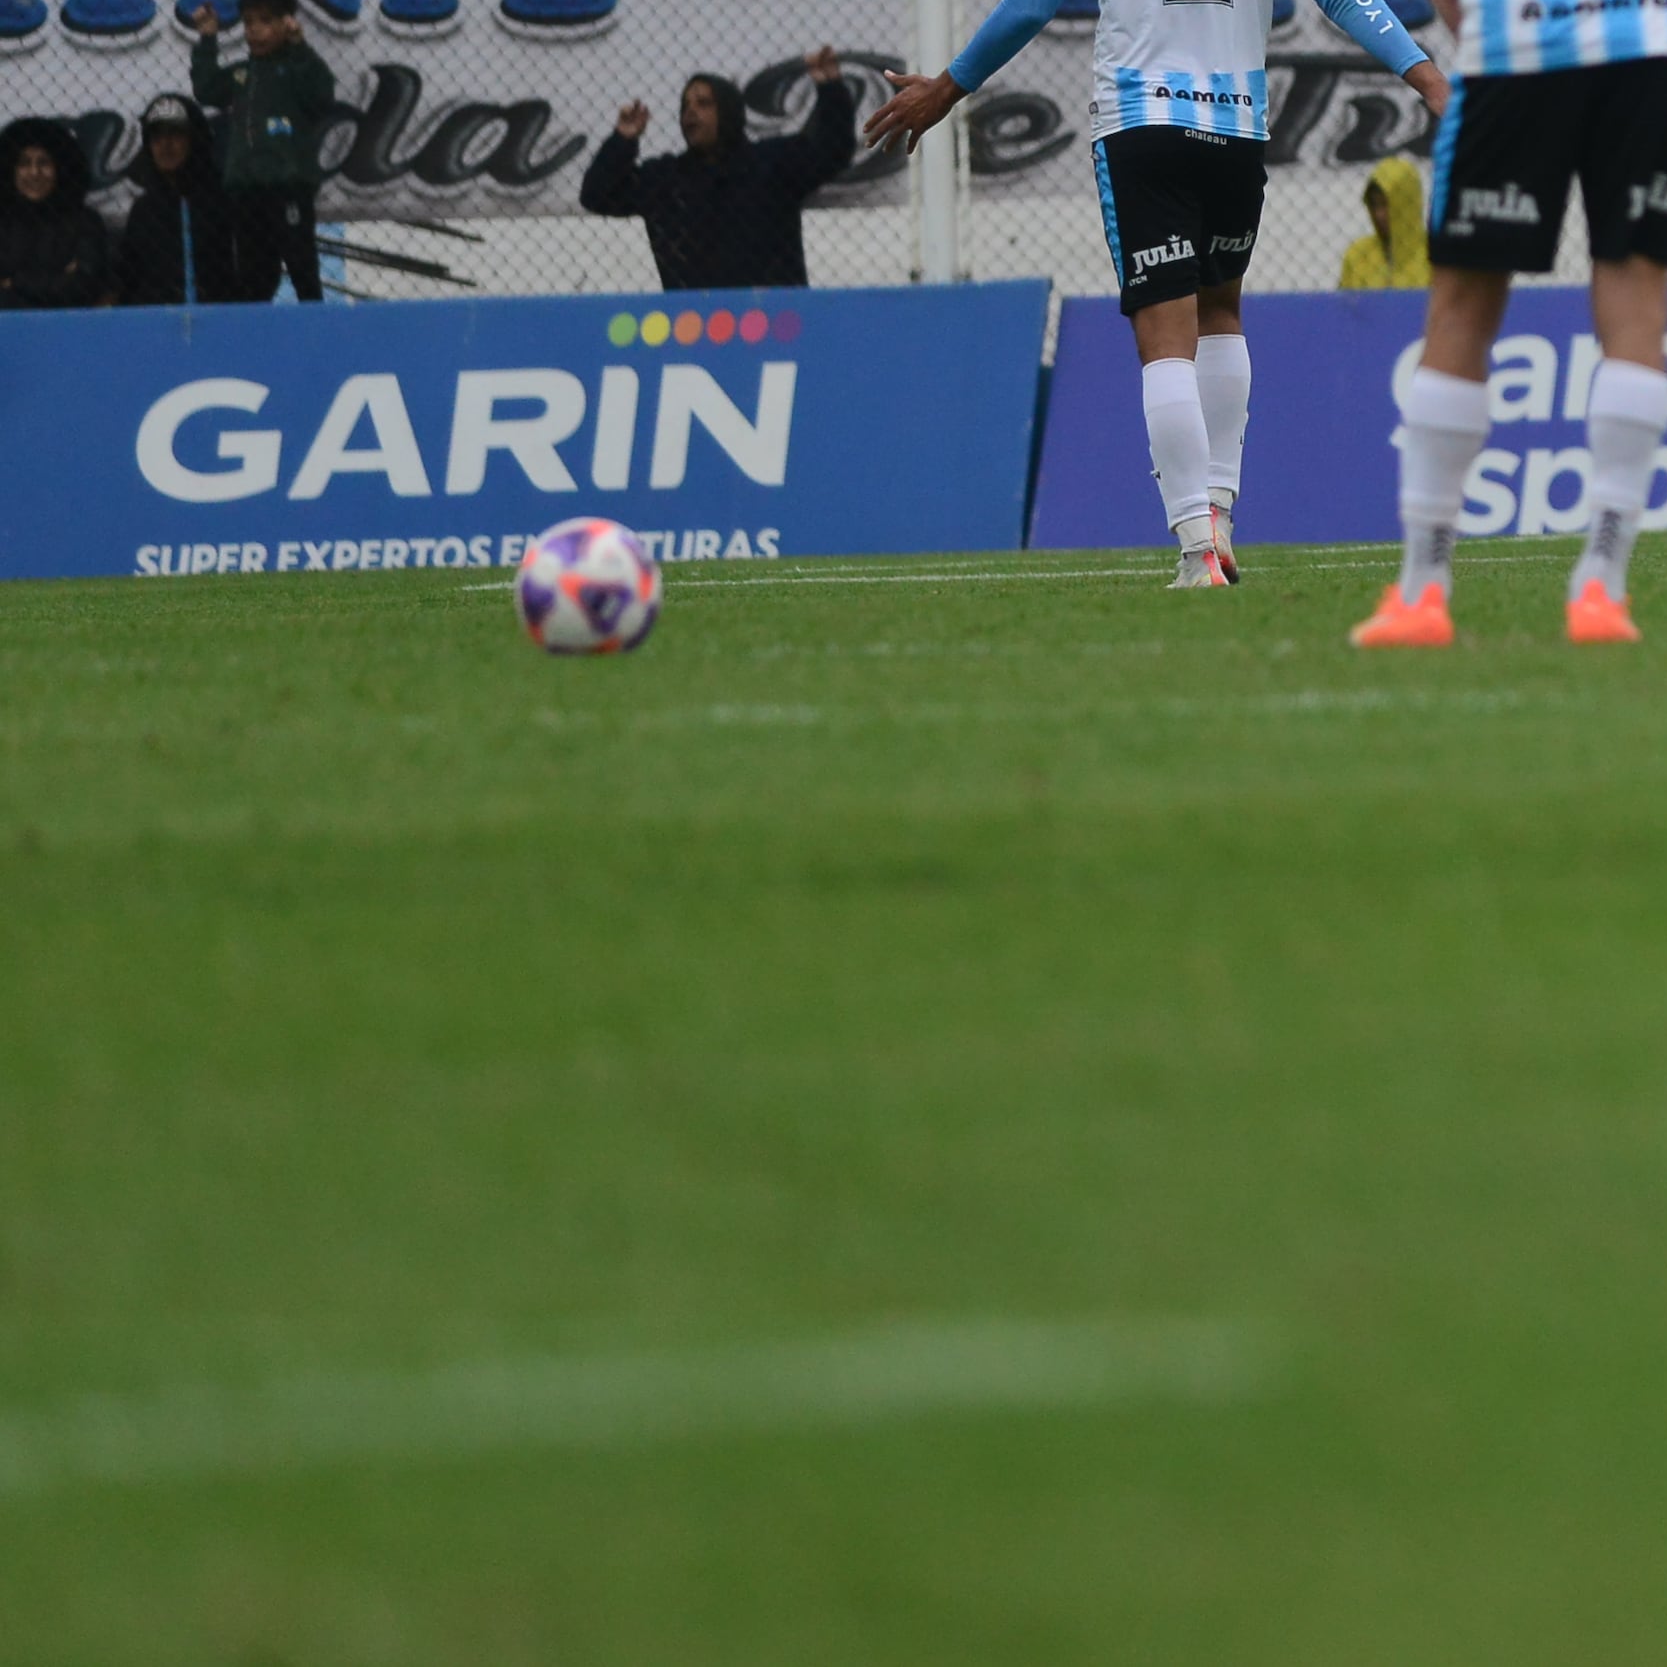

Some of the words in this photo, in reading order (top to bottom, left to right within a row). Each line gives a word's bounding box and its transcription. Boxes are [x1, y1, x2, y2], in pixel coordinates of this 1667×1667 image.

[1184, 128, 1228, 145] chateau
[1133, 239, 1195, 274] JULIA
[136, 361, 798, 503] GARIN
[134, 545, 264, 576] SUPER
[276, 539, 492, 572] EXPERTOS
